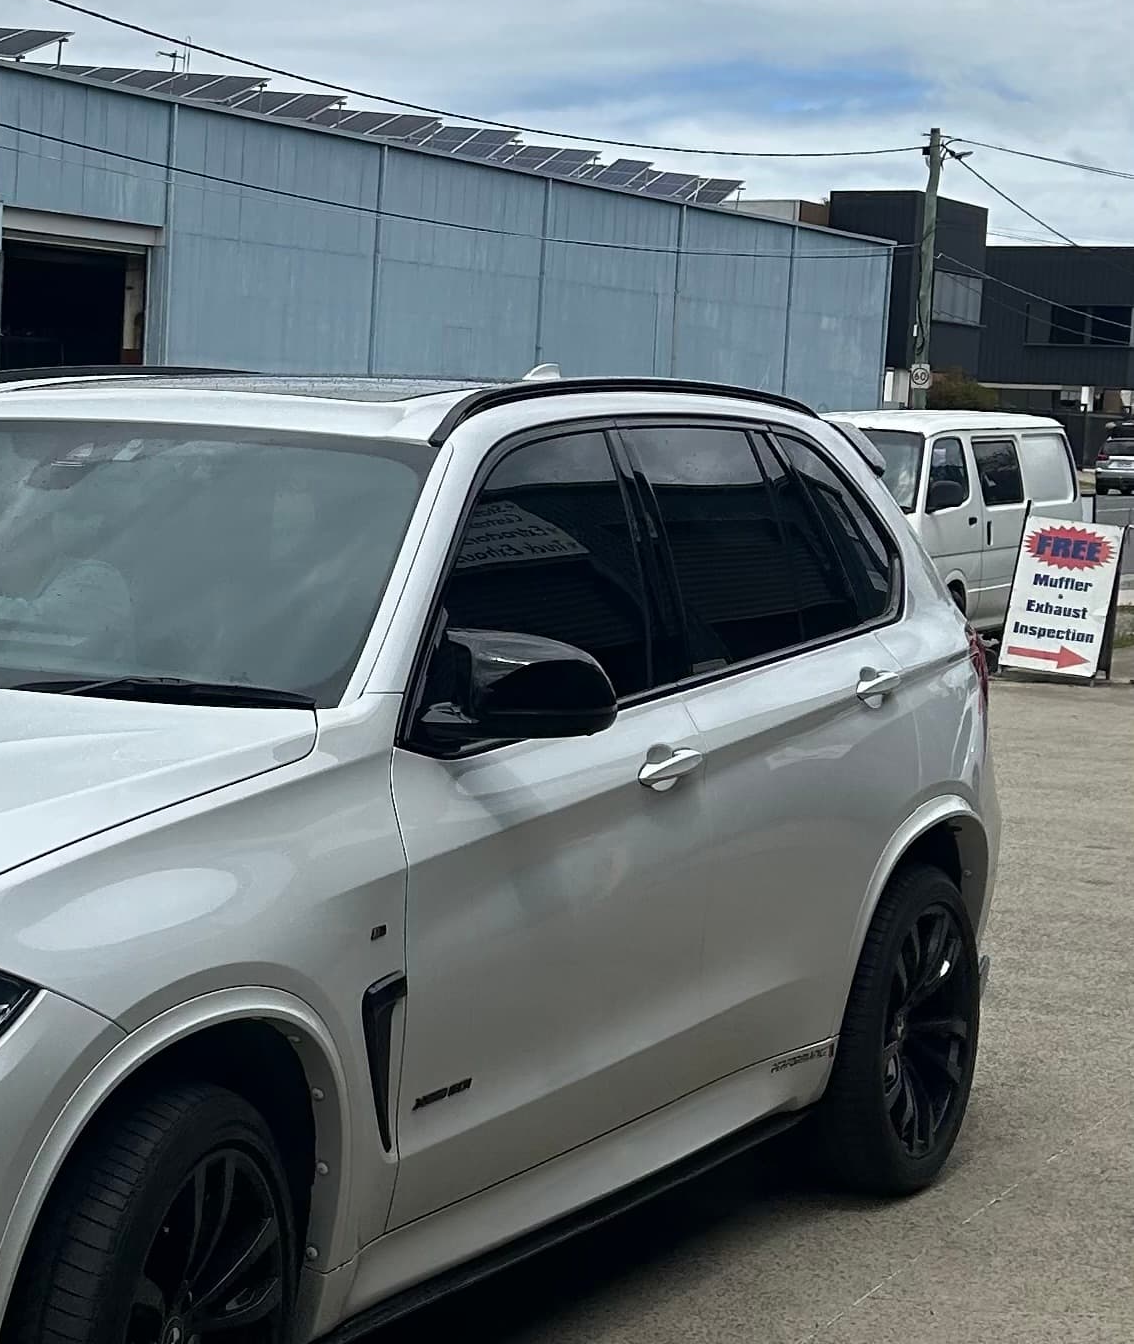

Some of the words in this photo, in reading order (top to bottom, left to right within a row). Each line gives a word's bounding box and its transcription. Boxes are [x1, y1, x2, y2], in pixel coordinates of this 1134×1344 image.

[1036, 533, 1102, 563] FREE
[1032, 573, 1093, 593] Muffler
[1025, 599, 1088, 620] Exhaust
[1013, 621, 1095, 644] Inspection
